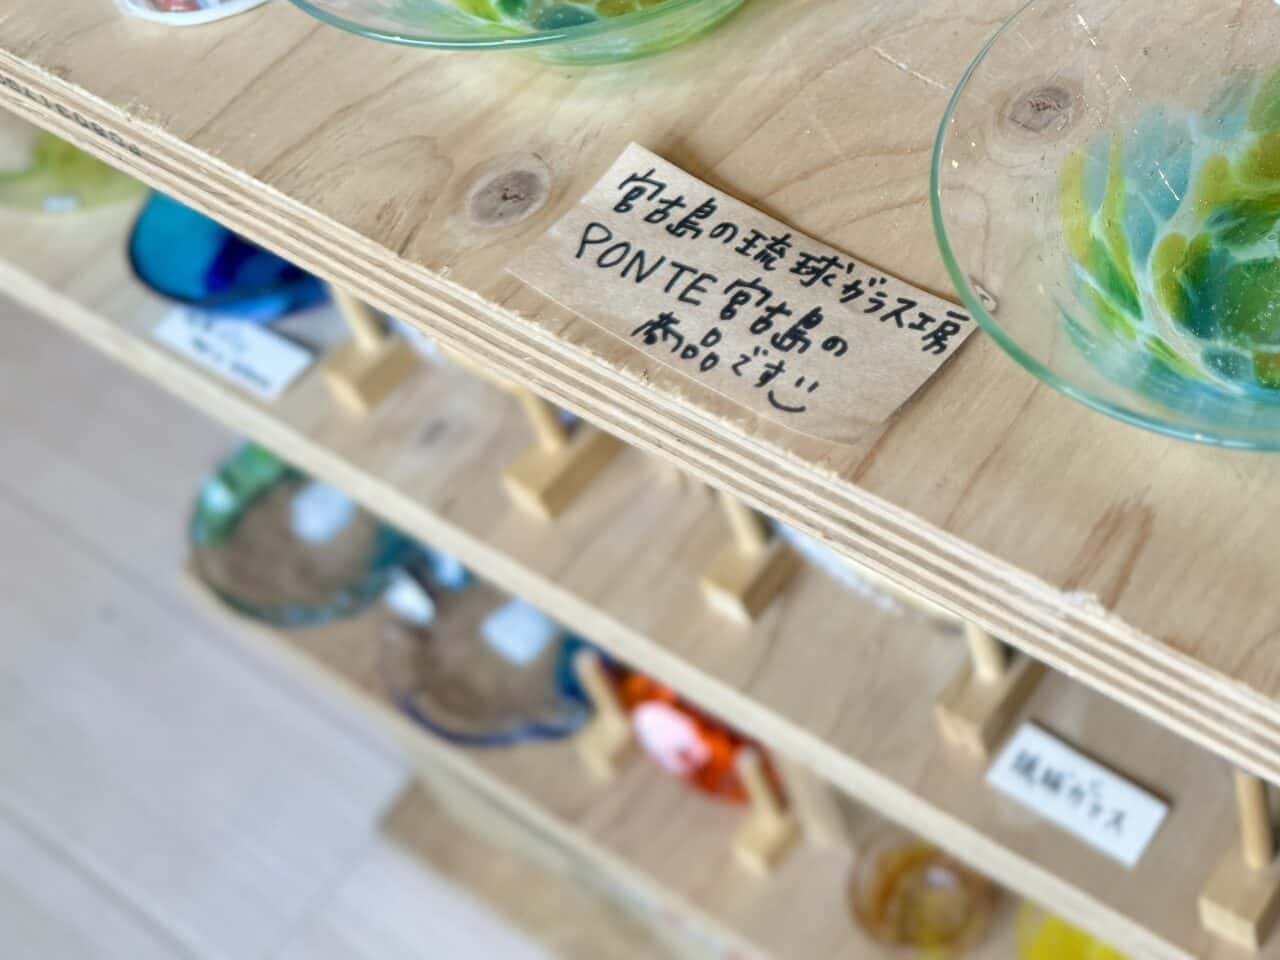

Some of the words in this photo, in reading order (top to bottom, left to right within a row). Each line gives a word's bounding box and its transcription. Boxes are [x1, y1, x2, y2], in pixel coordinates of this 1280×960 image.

[613, 167, 970, 357] 宮古島の琉球ガラス工房
